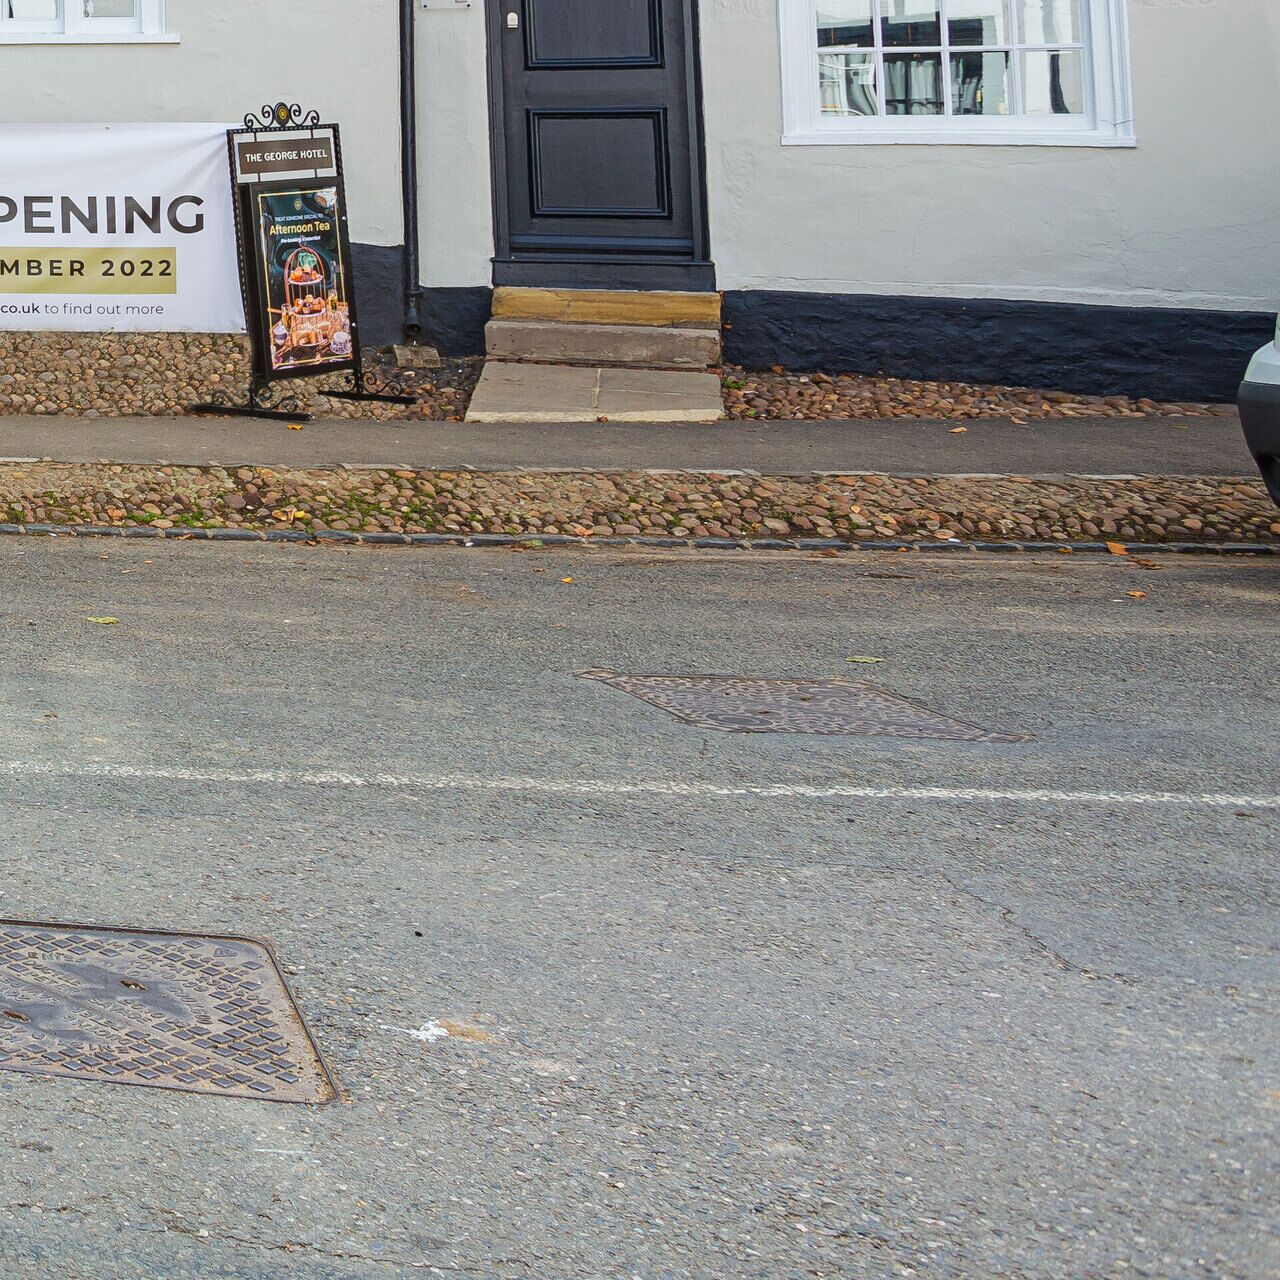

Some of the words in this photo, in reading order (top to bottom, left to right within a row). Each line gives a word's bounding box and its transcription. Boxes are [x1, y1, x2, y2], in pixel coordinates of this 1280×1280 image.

[245, 153, 263, 163] THE
[264, 151, 299, 161] GEORGE
[300, 149, 328, 159] HOTEL
[270, 223, 313, 236] Afternoon
[314, 221, 330, 231] Tea
[101, 259, 173, 277] 2022
[44, 303, 59, 315] to
[62, 303, 92, 315] find
[97, 303, 122, 315] out
[125, 305, 164, 315] more
